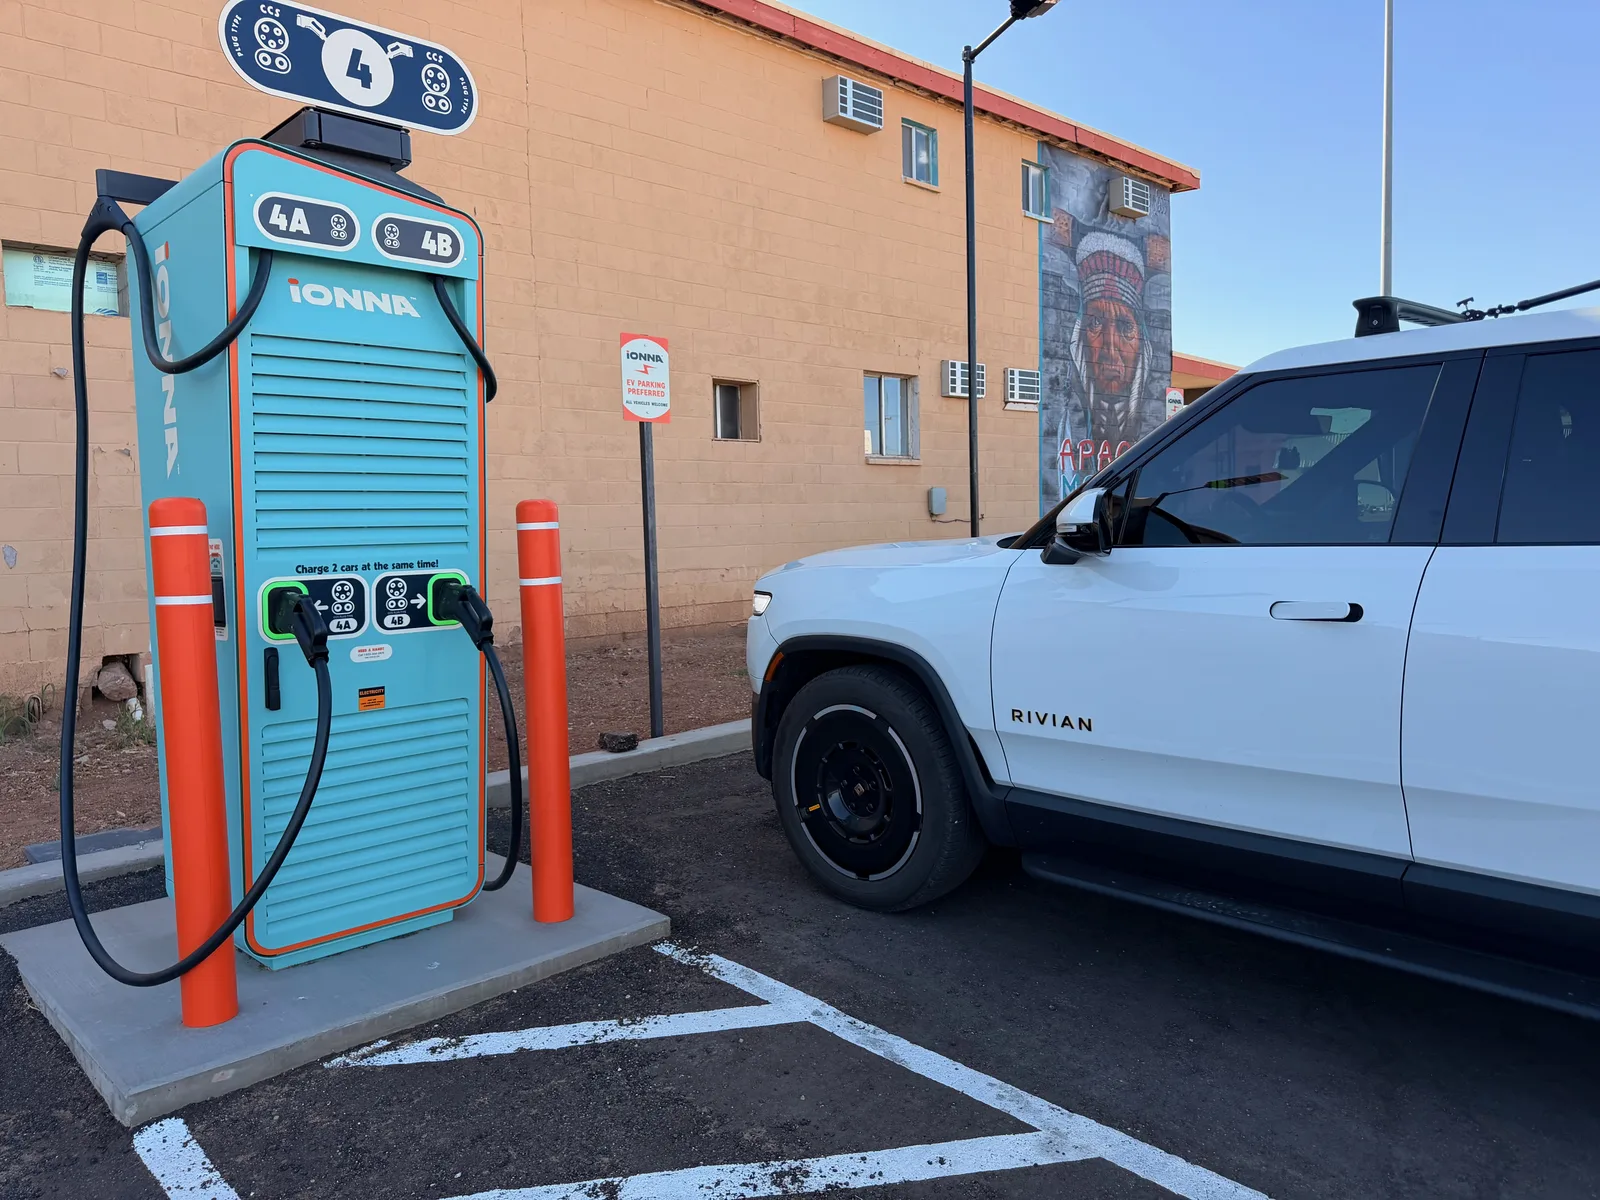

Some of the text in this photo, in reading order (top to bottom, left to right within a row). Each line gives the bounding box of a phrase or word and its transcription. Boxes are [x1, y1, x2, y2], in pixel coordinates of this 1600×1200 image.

[260, 4, 281, 18] CCS
[231, 14, 244, 57] PLUG TYPE
[426, 51, 443, 63] CCS
[346, 48, 372, 89] 4
[459, 76, 469, 114] PLUG TYPE
[268, 204, 311, 235] 4A
[421, 230, 452, 257] 4B
[627, 388, 665, 397] PREFERRED
[637, 380, 666, 389] PARKING
[295, 559, 439, 575] Charge 2 cars at the same time!
[336, 620, 351, 630] 4A
[390, 616, 404, 626] 4B
[1011, 708, 1092, 732] RIVIAN
